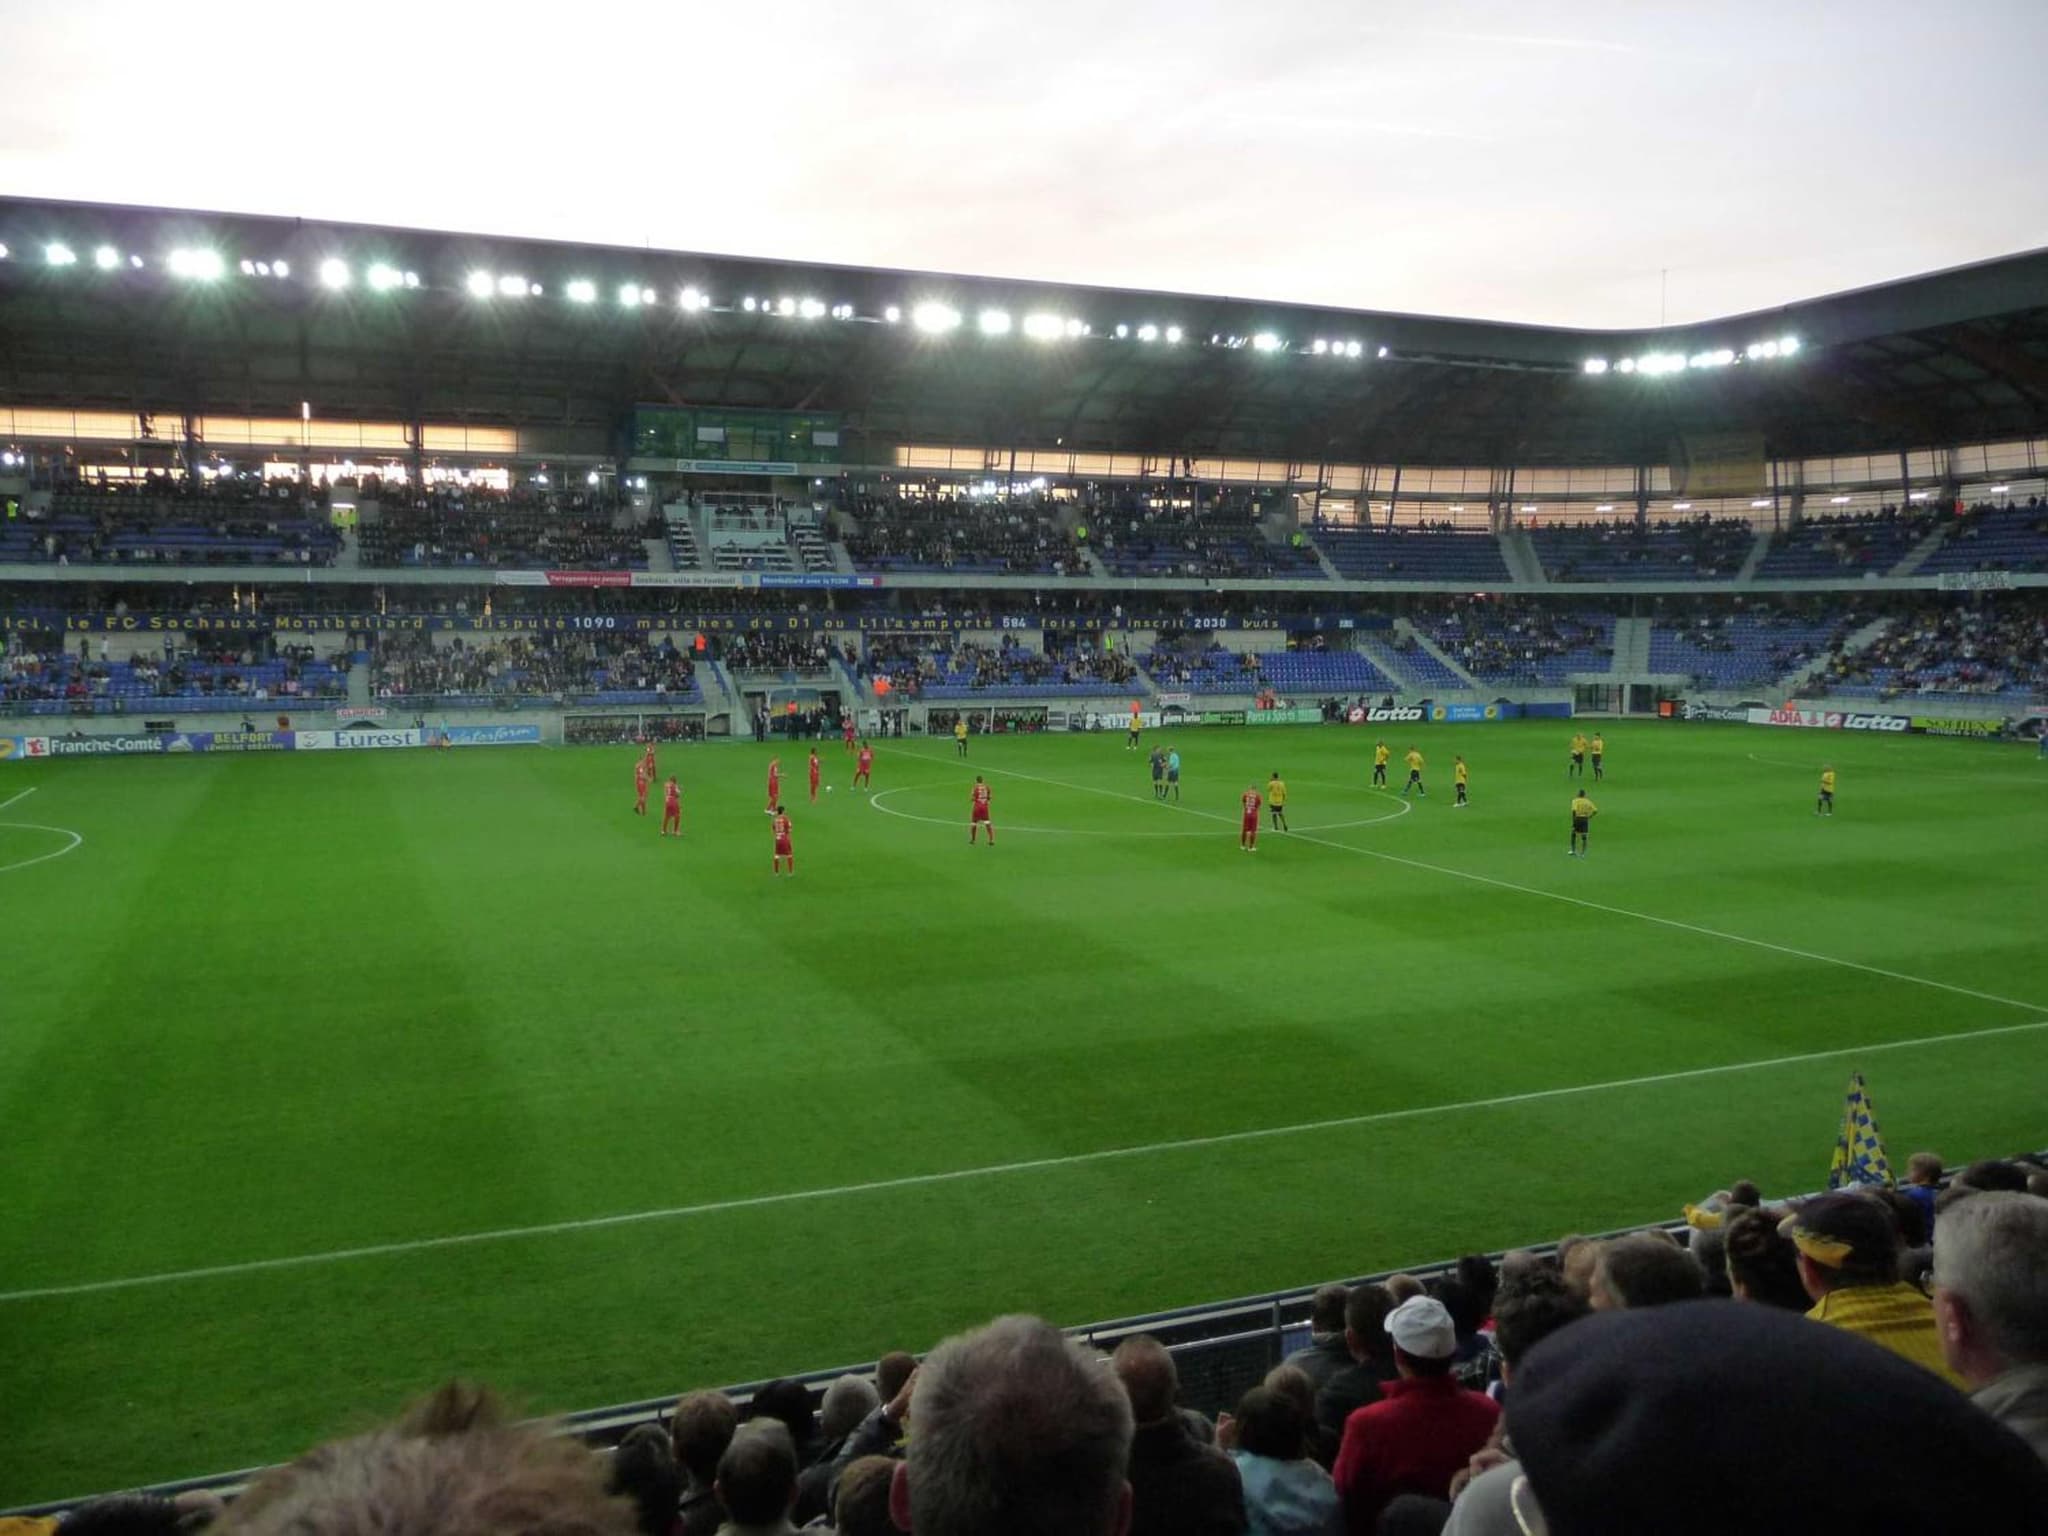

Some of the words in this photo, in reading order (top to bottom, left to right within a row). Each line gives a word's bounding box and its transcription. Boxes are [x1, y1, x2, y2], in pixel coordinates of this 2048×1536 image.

[66, 616, 89, 630] le
[105, 616, 138, 630] FC
[473, 616, 566, 631] disputé
[573, 616, 616, 629] 1090
[636, 617, 734, 630] matches
[750, 617, 773, 629] de
[788, 617, 809, 629] D1
[825, 619, 844, 629] ou
[911, 616, 992, 631] emporté
[1040, 617, 1076, 629] fois
[51, 736, 162, 753] Franche-Comté
[213, 732, 273, 744] BELFORT
[334, 730, 414, 748] Eurest
